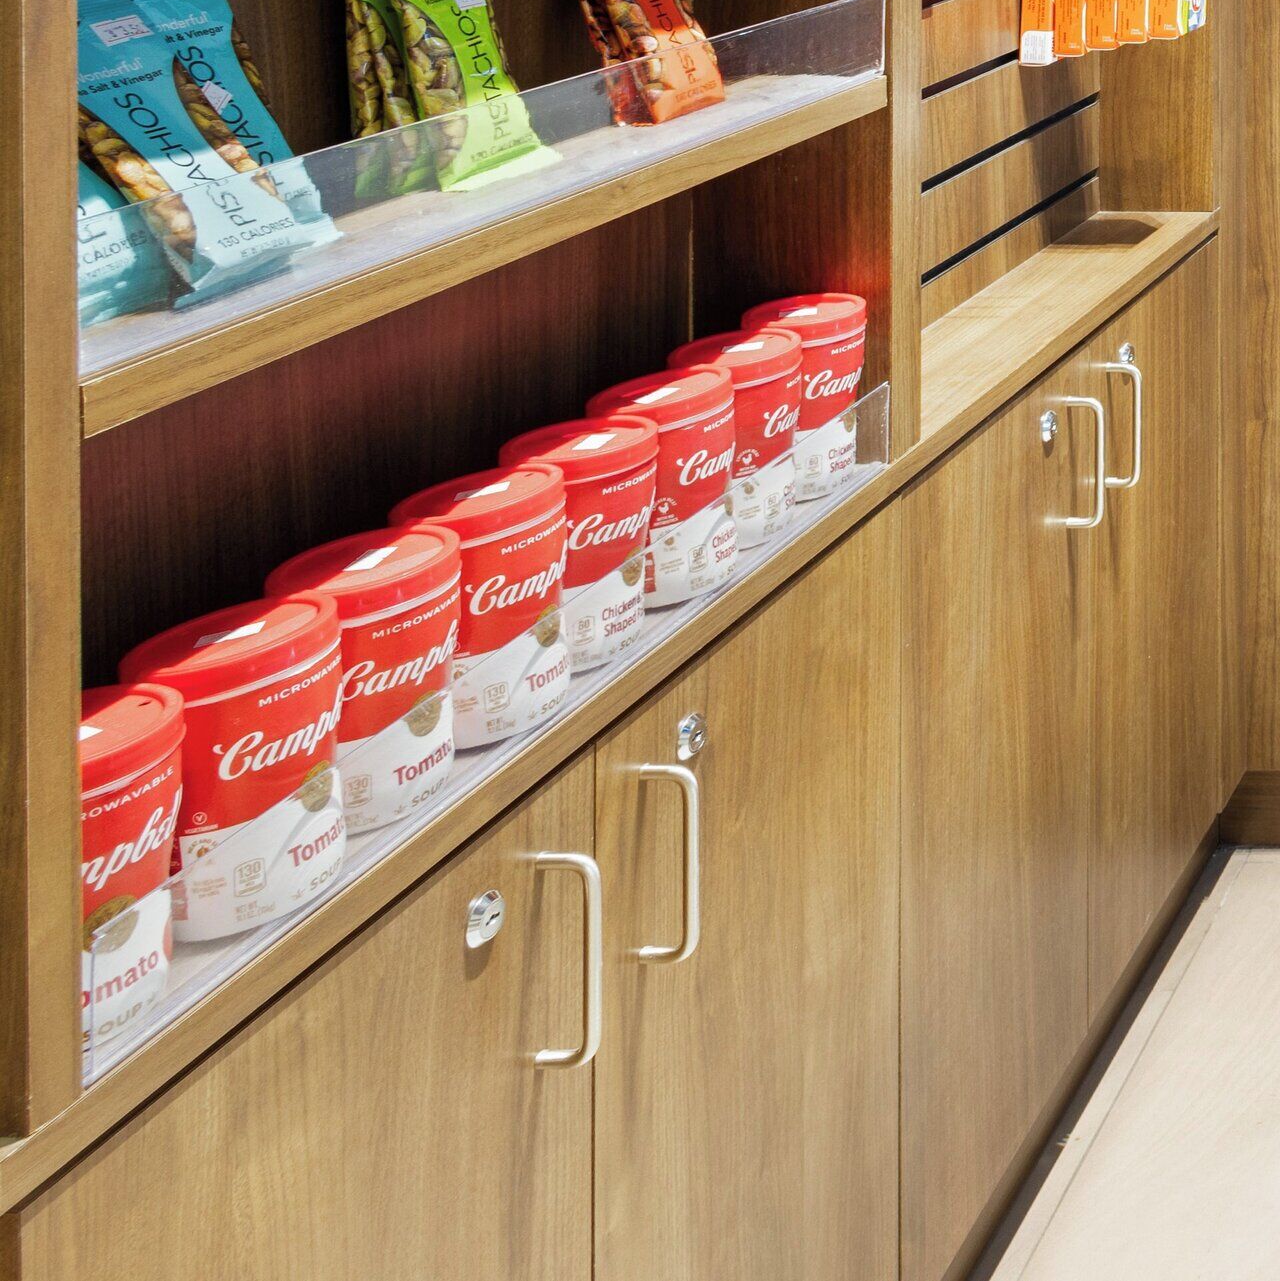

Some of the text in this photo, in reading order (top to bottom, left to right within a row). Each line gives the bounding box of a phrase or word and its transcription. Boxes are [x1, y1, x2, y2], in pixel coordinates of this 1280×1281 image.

[185, 24, 224, 41] Vinegar
[88, 68, 163, 95] Salt & Vinegar
[217, 217, 295, 250] 130 CALORIES
[238, 860, 262, 880] 130
